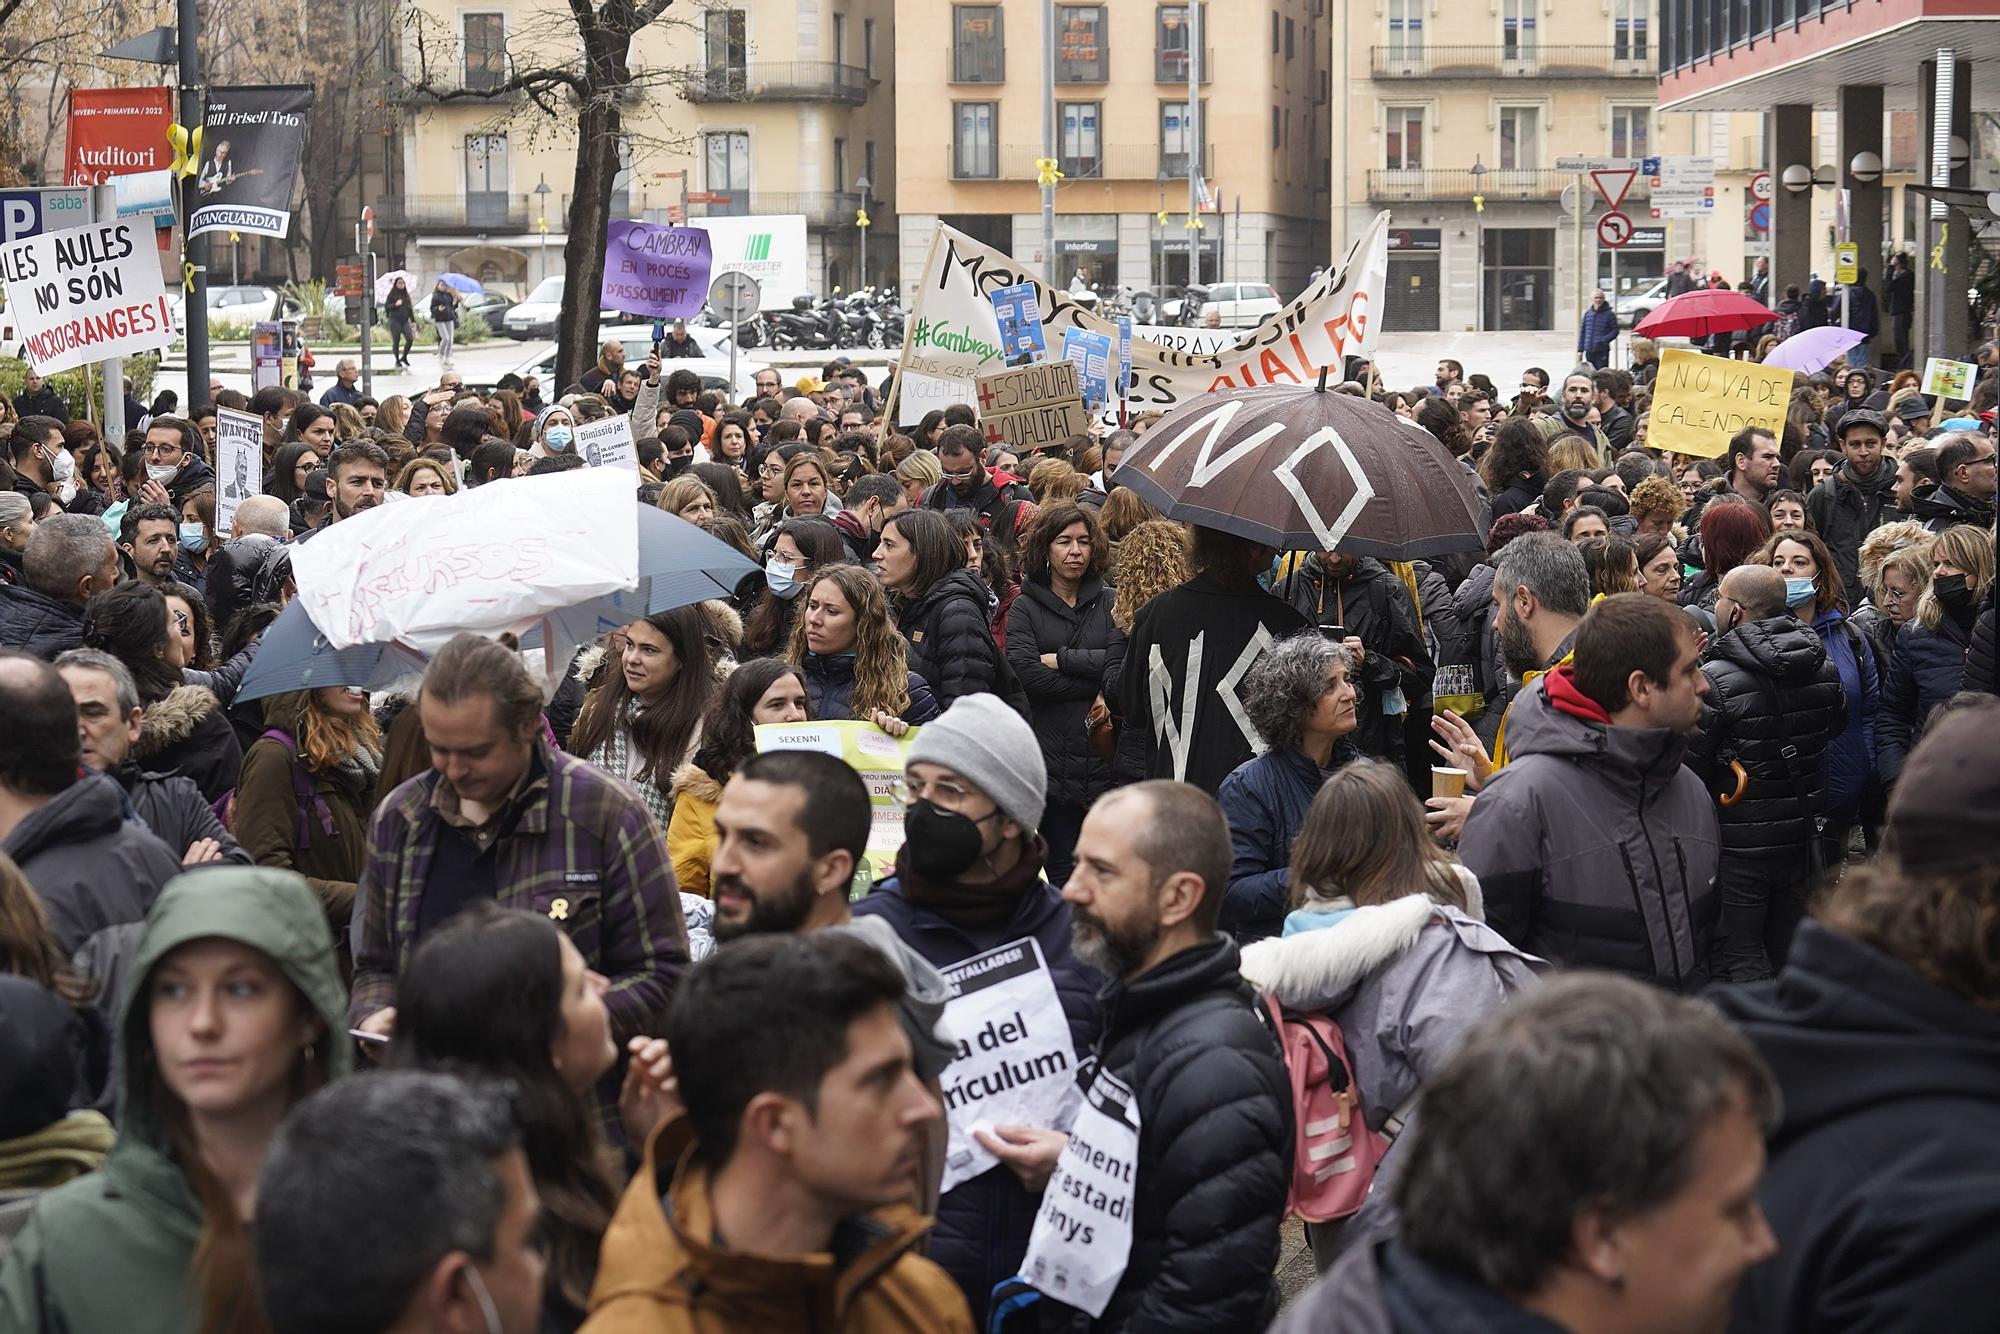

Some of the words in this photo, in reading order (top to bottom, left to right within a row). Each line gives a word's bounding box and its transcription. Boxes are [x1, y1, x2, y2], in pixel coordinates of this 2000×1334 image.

[103, 107, 140, 116] PRIMAVERA
[144, 106, 163, 115] 2022
[207, 112, 226, 128] Bill
[227, 111, 269, 126] Frisell
[271, 110, 299, 127] Trio
[77, 146, 156, 167] Auditori
[1556, 161, 1585, 170] Salvador
[49, 193, 83, 210] saba
[3, 244, 39, 283] LES
[55, 225, 133, 273] AULES
[626, 226, 702, 257] CAMBRAY
[620, 260, 638, 275] EN
[646, 261, 691, 281] PROCÉS
[34, 282, 59, 315] NO
[67, 264, 123, 304] SÓN
[913, 316, 1004, 366] #Cambray
[906, 355, 938, 374] INS
[994, 363, 1076, 408] ESTABILITAT
[1673, 363, 1712, 393] NO
[1723, 370, 1751, 400] VA
[1758, 379, 1783, 406] DE
[220, 420, 260, 446] WANTED
[580, 424, 613, 441] Dimissió
[613, 422, 624, 435] ja!
[1001, 405, 1073, 446] QUALITAT
[1148, 400, 1375, 553] NO
[778, 735, 821, 744] SEXENNI
[874, 784, 891, 795] DIÀ
[977, 1011, 1028, 1051] del
[943, 1049, 1068, 1110] rículum
